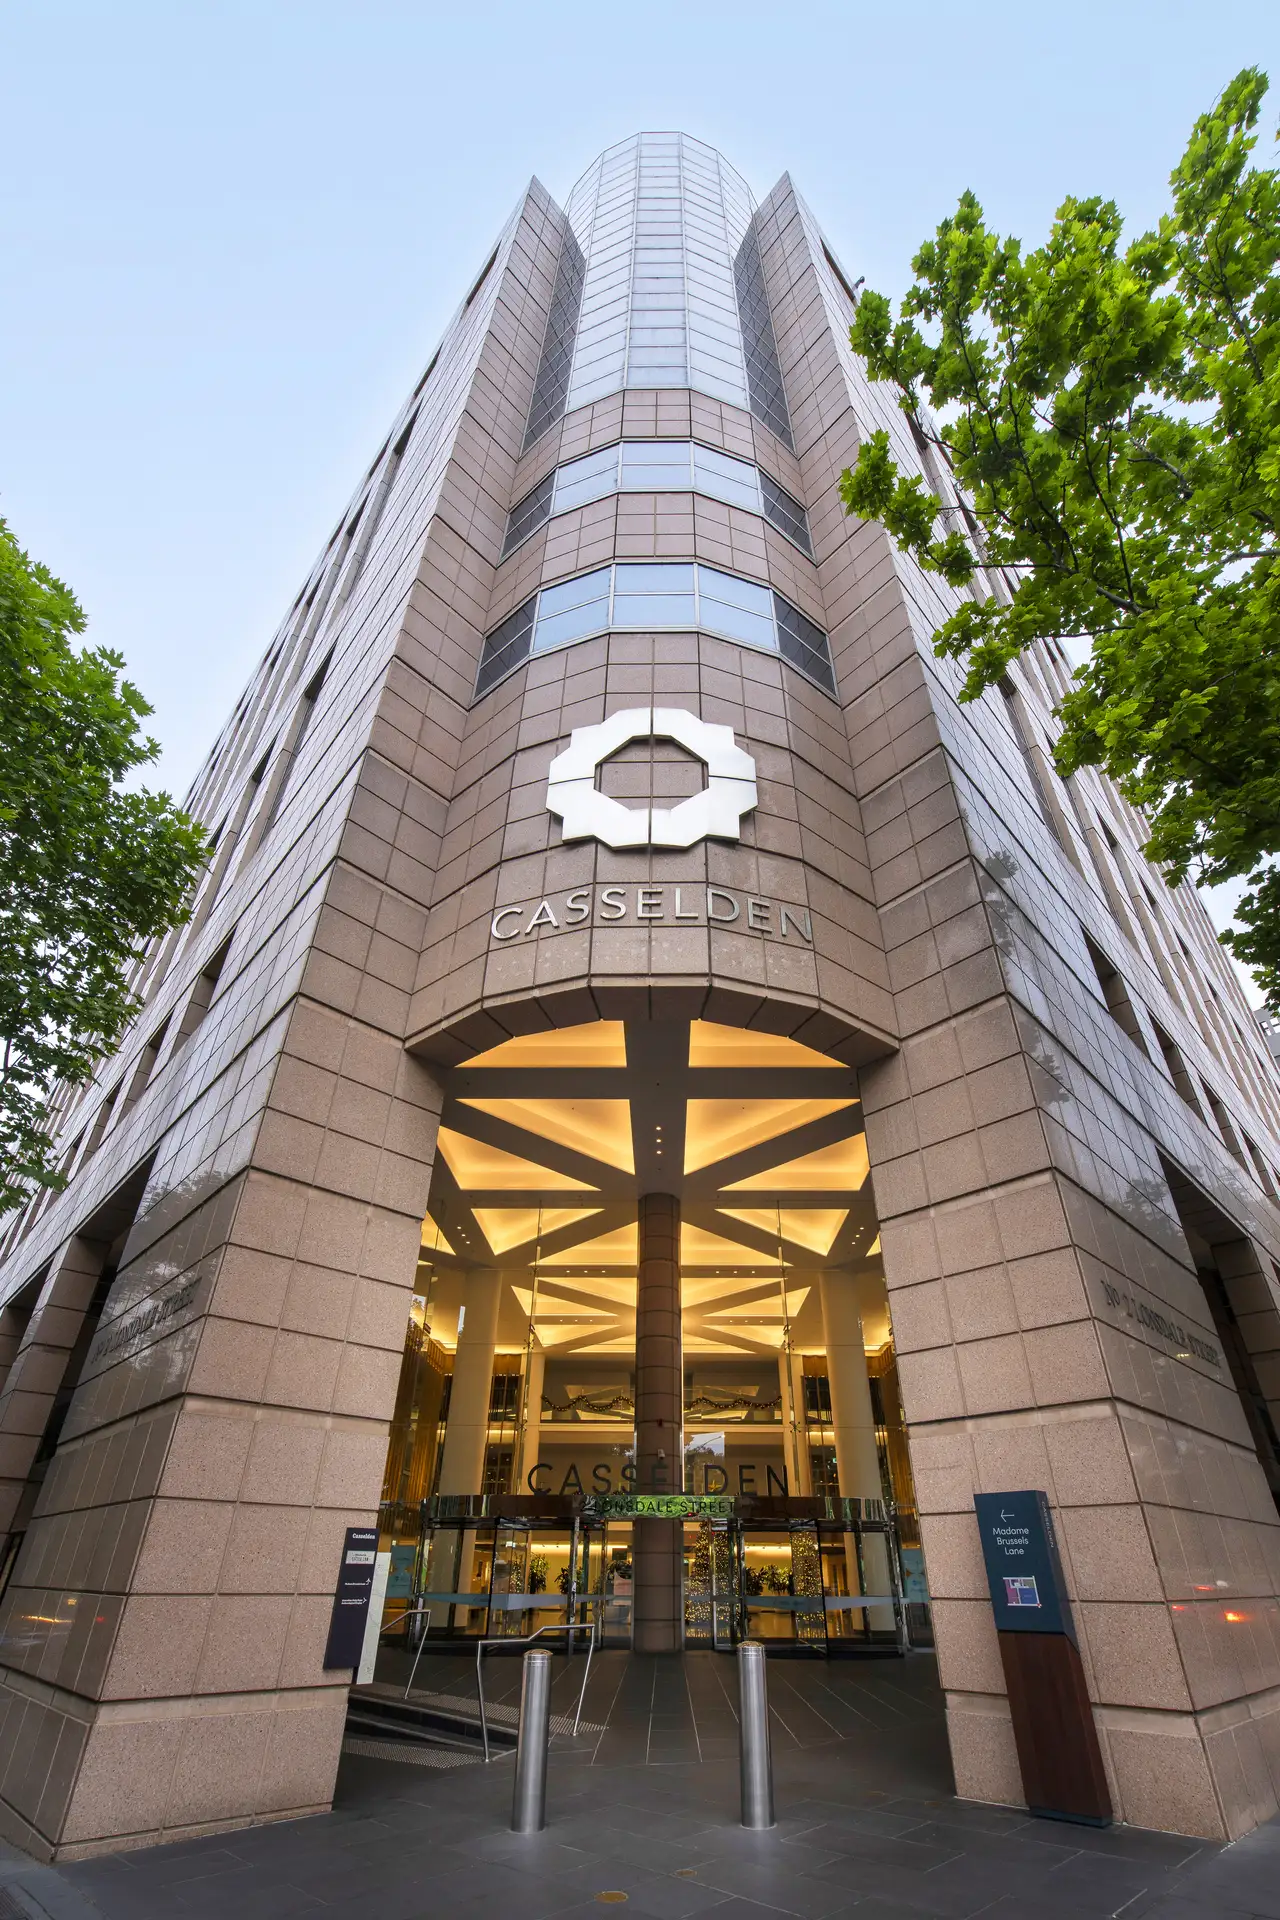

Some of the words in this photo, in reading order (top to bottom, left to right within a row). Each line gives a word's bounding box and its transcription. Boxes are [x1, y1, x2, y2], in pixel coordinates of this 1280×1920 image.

[491, 887, 813, 943] CASSELDEN
[1122, 1292, 1133, 1318] 2
[1130, 1296, 1188, 1349] LONSDALE
[1186, 1331, 1223, 1369] STREET
[595, 1500, 672, 1513] LONSDALE
[680, 1500, 735, 1513] STREET
[992, 1527, 1029, 1535] Madame
[996, 1537, 1029, 1545] Brussels
[1004, 1547, 1024, 1555] Lane
